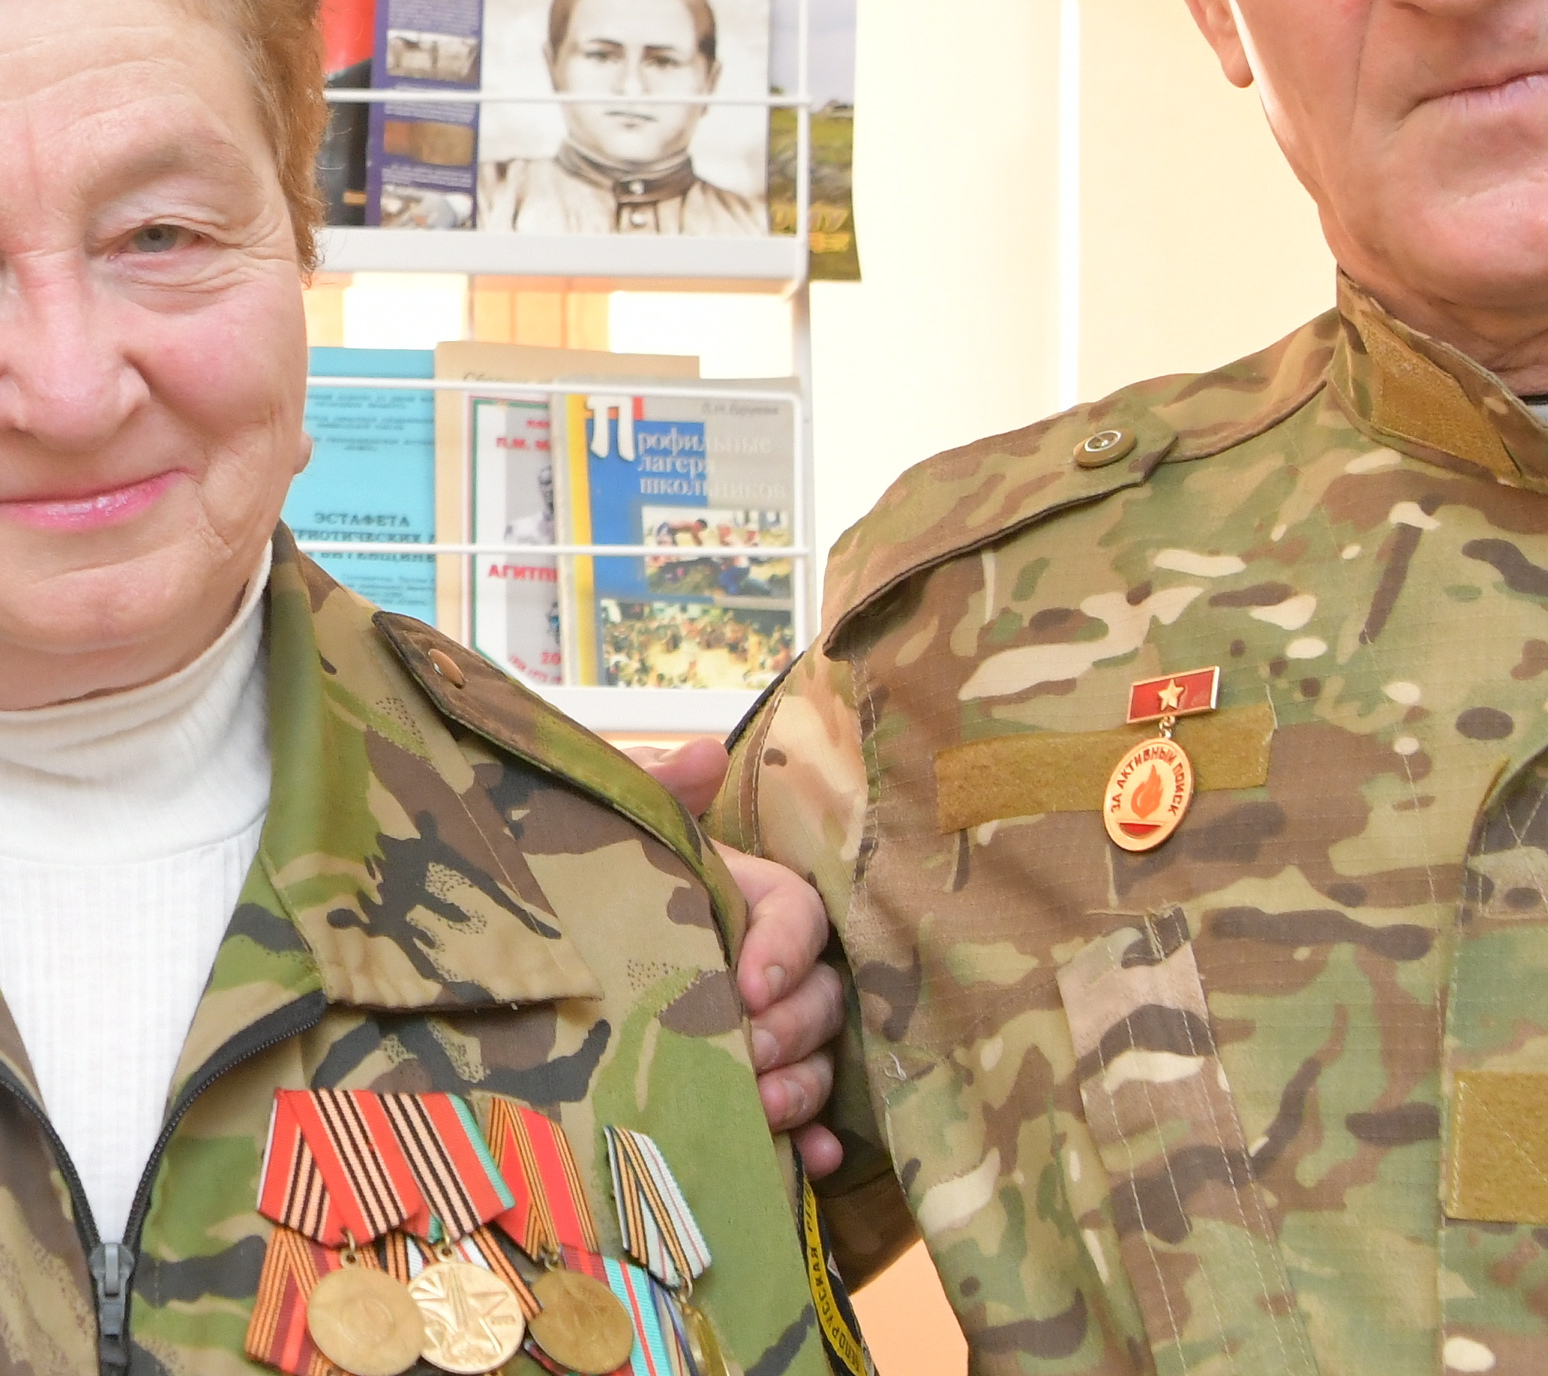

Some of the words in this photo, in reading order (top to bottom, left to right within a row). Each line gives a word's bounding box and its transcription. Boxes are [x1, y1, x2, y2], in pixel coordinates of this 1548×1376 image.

[638, 455, 715, 479] лагеря
[314, 512, 410, 528] ЭСТАФЕТА
[489, 564, 559, 583] АГИТП
[1116, 746, 1177, 790] АКТИВНЫЙ
[1167, 762, 1185, 817] ПОИСК
[1110, 792, 1123, 814] ЗА
